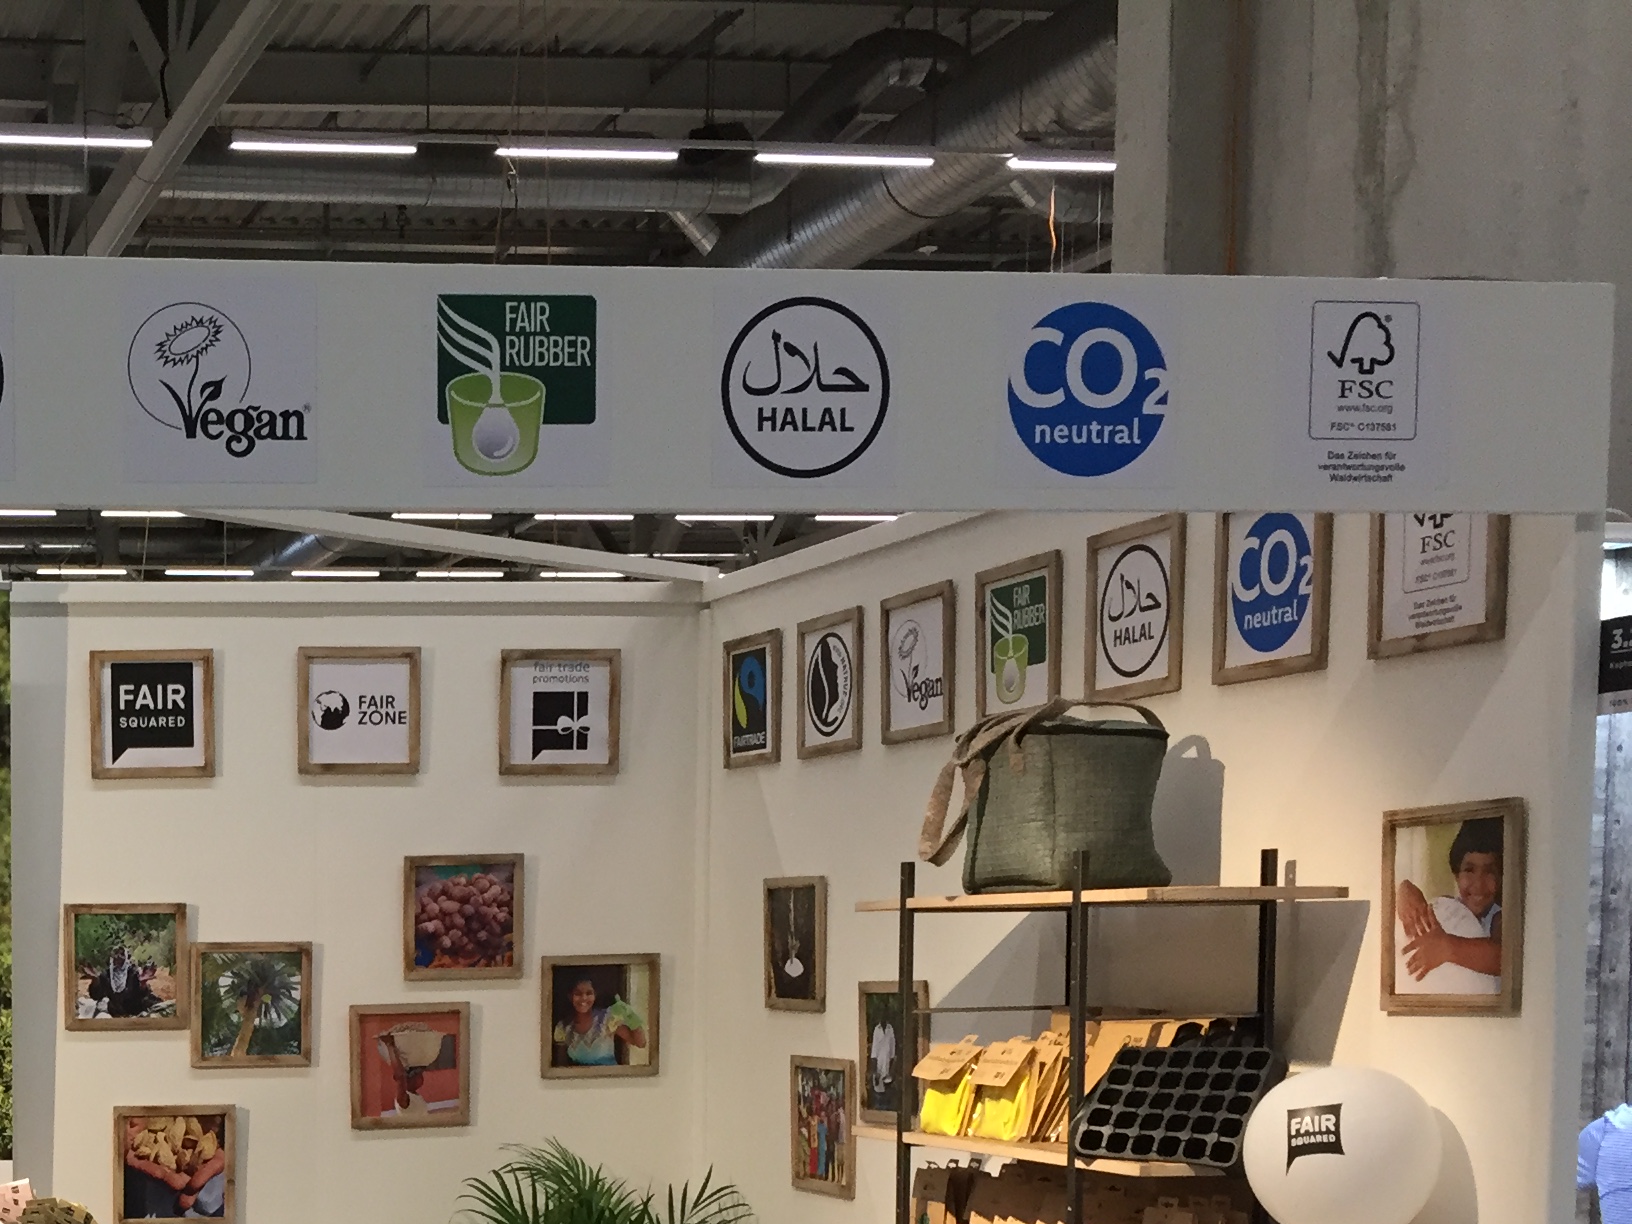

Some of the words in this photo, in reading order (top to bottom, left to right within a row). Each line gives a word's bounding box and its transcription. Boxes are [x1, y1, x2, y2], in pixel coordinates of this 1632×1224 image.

[504, 301, 551, 333] FAIR
[505, 336, 592, 367] RUBBER
[1337, 379, 1394, 399] FSC
[757, 407, 855, 433] HALAL
[1034, 417, 1142, 445] neutral
[1420, 530, 1456, 554] FSC
[1013, 584, 1031, 608] FAIR
[1013, 602, 1046, 631] RUBBER
[1242, 600, 1299, 631] neutral
[1112, 624, 1155, 648] HALAL
[532, 674, 590, 685] promotions
[556, 661, 591, 674] trade
[119, 684, 186, 710] FAIR
[357, 695, 396, 709] FAIR
[119, 716, 186, 729] SQUARED
[357, 710, 408, 726] ZONE
[1291, 1114, 1337, 1135] FAIR
[1290, 1133, 1336, 1147] SQUARED
